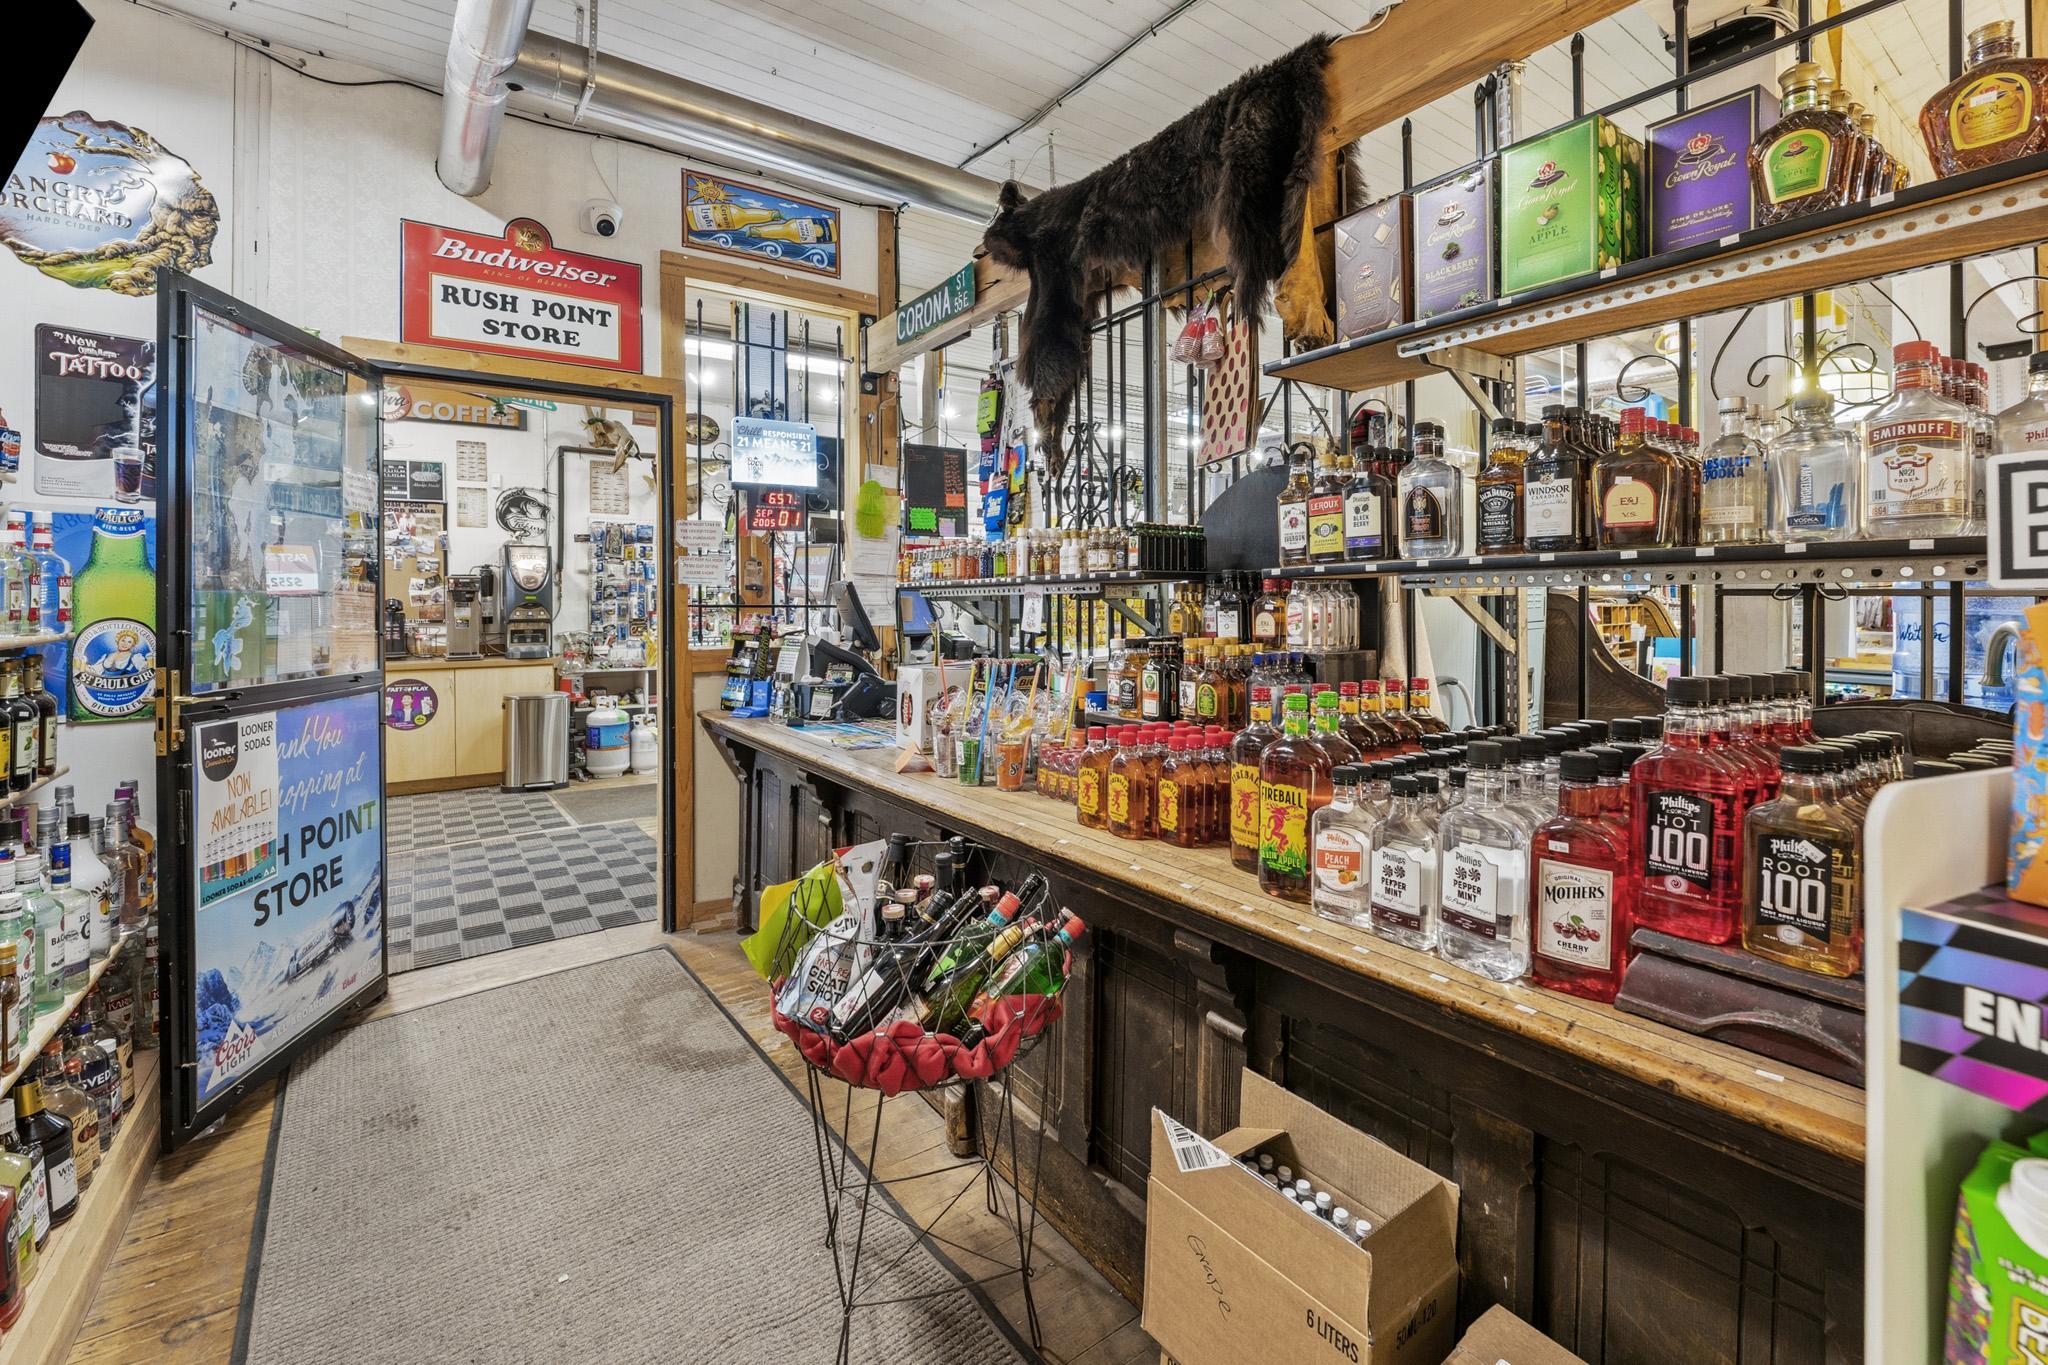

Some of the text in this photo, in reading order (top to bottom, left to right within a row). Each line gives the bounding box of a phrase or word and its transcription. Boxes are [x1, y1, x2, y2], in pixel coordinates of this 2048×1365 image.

[1665, 168, 1700, 188] Crown
[27, 213, 101, 232] HARD CIDER
[700, 207, 713, 228] Light
[1529, 226, 1569, 245] APPLE
[432, 237, 617, 287] Budweiser
[1425, 256, 1481, 281] BLACKBERRY
[483, 268, 512, 279] KING
[956, 270, 967, 291] ST
[441, 284, 613, 328] RUSH POINT
[898, 286, 951, 341] CORONA
[482, 319, 582, 348] STORE
[737, 425, 811, 441] Chill RESPONSIBLY
[1873, 422, 1944, 442] SMIRNOFF
[2025, 428, 2048, 443] Phil
[736, 436, 812, 453] 21 MEANS 21
[1702, 455, 1752, 470] ABSOLUT
[1800, 466, 1813, 506] AMSTERDAM
[1894, 476, 1921, 484] VODKA
[1527, 484, 1571, 497] WINDSOR
[1531, 493, 1565, 501] CANADIAN
[1310, 500, 1340, 513] LEROUX
[1620, 497, 1639, 506] E&J
[755, 508, 773, 518] SEP
[1793, 516, 1820, 524] VODKA
[91, 677, 130, 690] PAULI
[129, 666, 157, 686] GIRL
[241, 720, 274, 737] LOONER
[277, 715, 344, 761] ank You
[203, 744, 237, 760] looner
[244, 736, 271, 752] SODAS
[345, 751, 367, 786] at
[226, 770, 251, 801] NOW
[1260, 785, 1304, 810] FIREBALL
[1660, 796, 1701, 815] Phillips
[210, 788, 272, 836] AVAILABLE!
[300, 800, 376, 859] POINT
[1656, 814, 1702, 831] HOT
[1326, 832, 1350, 846] Phillips
[1649, 824, 1709, 871] 100
[1277, 856, 1302, 869] APPLE
[1324, 851, 1351, 866] PEACH
[1382, 850, 1407, 866] Phillips
[1455, 851, 1483, 868] Phillips
[1762, 857, 1826, 880] ROOT
[1381, 876, 1407, 892] PEPPER
[1452, 878, 1482, 896] PEPPER
[1554, 875, 1582, 883] ORIGINAL
[253, 854, 344, 928] STORE
[1384, 886, 1403, 899] MINT
[1456, 889, 1477, 903] MINT
[1544, 885, 1605, 904] MOTHERS
[1760, 869, 1826, 921] 100
[1557, 940, 1590, 953] CHERRY
[808, 964, 848, 993] GELAT
[214, 1031, 257, 1067] Coors
[219, 1048, 252, 1077] LIGHT
[82, 1069, 112, 1091] SVED
[1186, 1234, 1233, 1323] Grape
[1306, 1308, 1360, 1365] 6 LITERS
